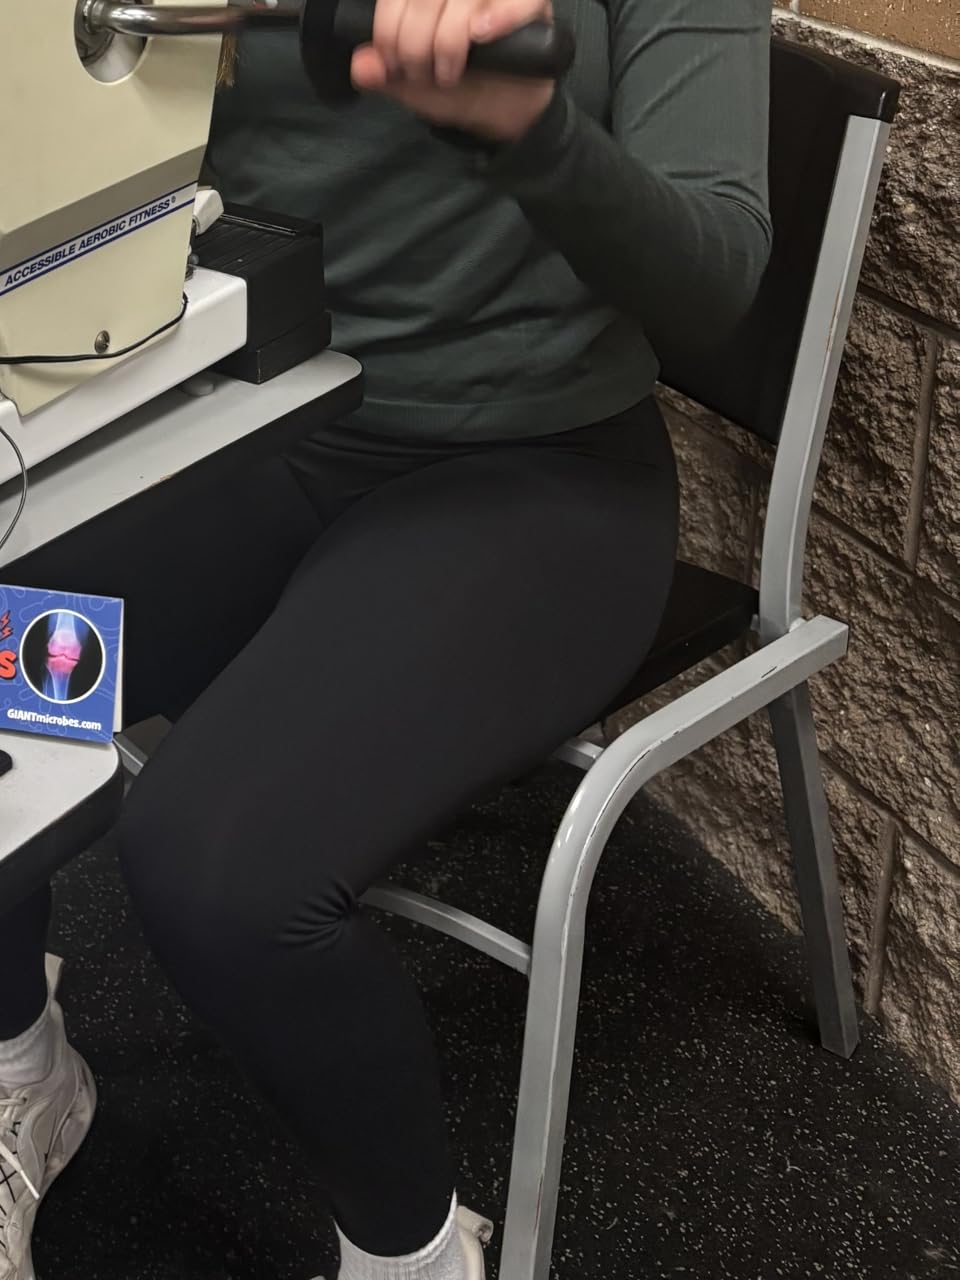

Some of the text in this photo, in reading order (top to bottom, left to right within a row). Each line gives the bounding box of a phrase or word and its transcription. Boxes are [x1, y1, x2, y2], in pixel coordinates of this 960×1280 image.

[5, 246, 76, 287] ACCESSIBLE
[78, 221, 126, 251] AEROBIC
[7, 708, 102, 731] GIANTmicrobes.com
